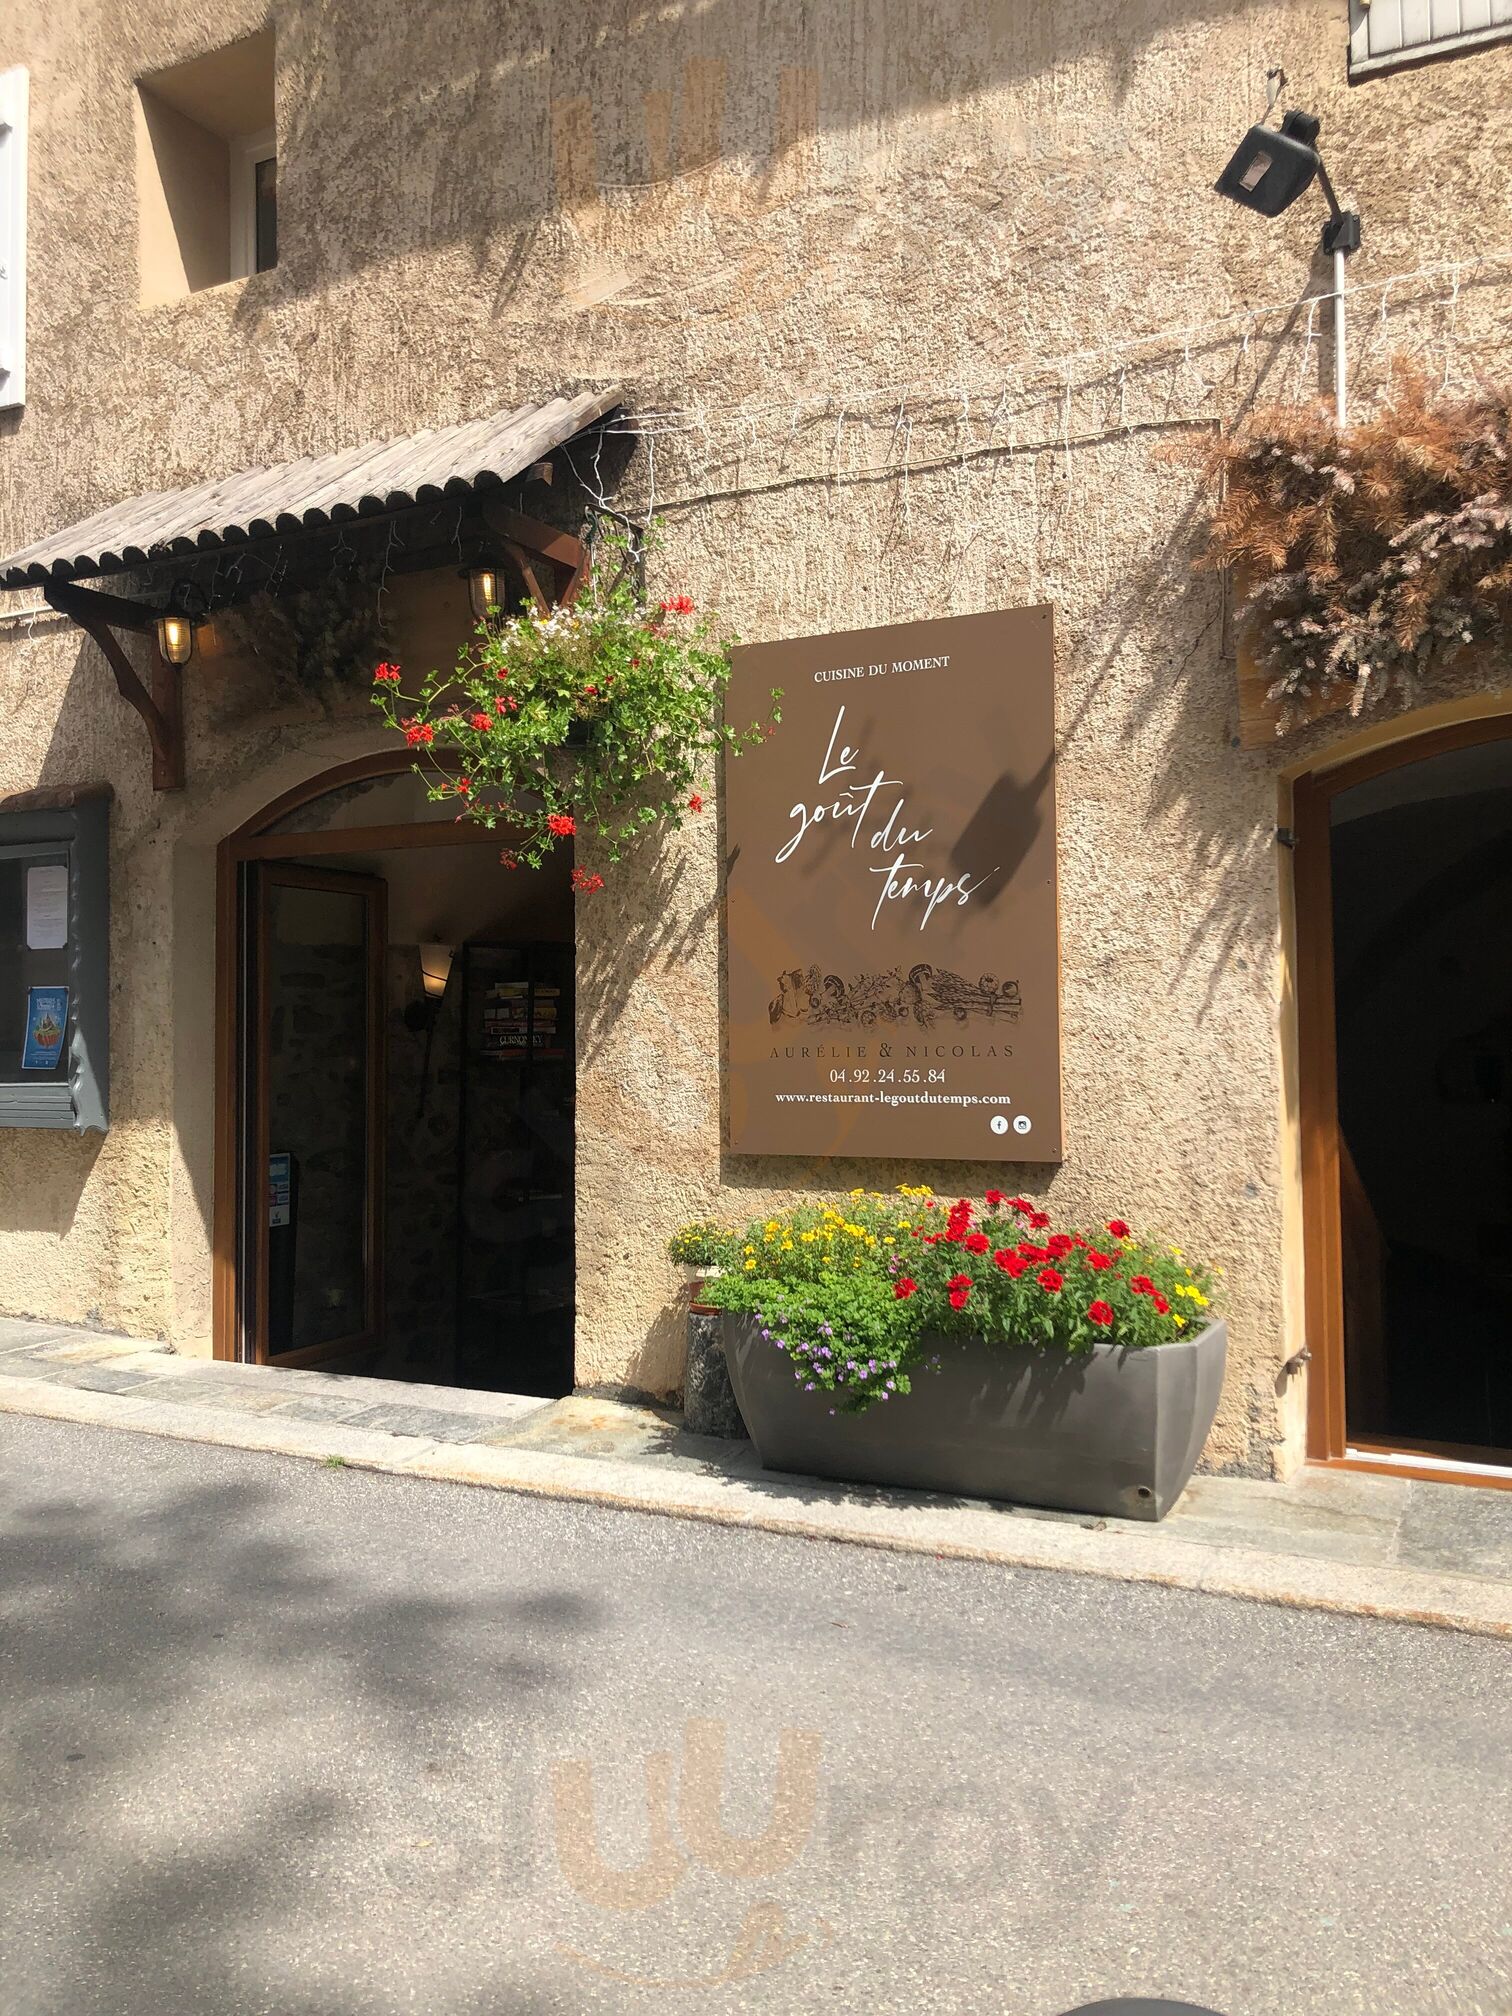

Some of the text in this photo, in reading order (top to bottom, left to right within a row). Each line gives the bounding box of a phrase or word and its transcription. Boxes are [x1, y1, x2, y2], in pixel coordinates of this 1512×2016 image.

[814, 655, 950, 683] CUISINE DU MOMENT
[818, 705, 860, 785] Le
[774, 770, 933, 864] goût du
[869, 853, 1000, 931] temps
[769, 1042, 1014, 1058] AURÉLIE & NICOLAS
[775, 1090, 1012, 1108] www.restaurant-legoutdutemps.com
